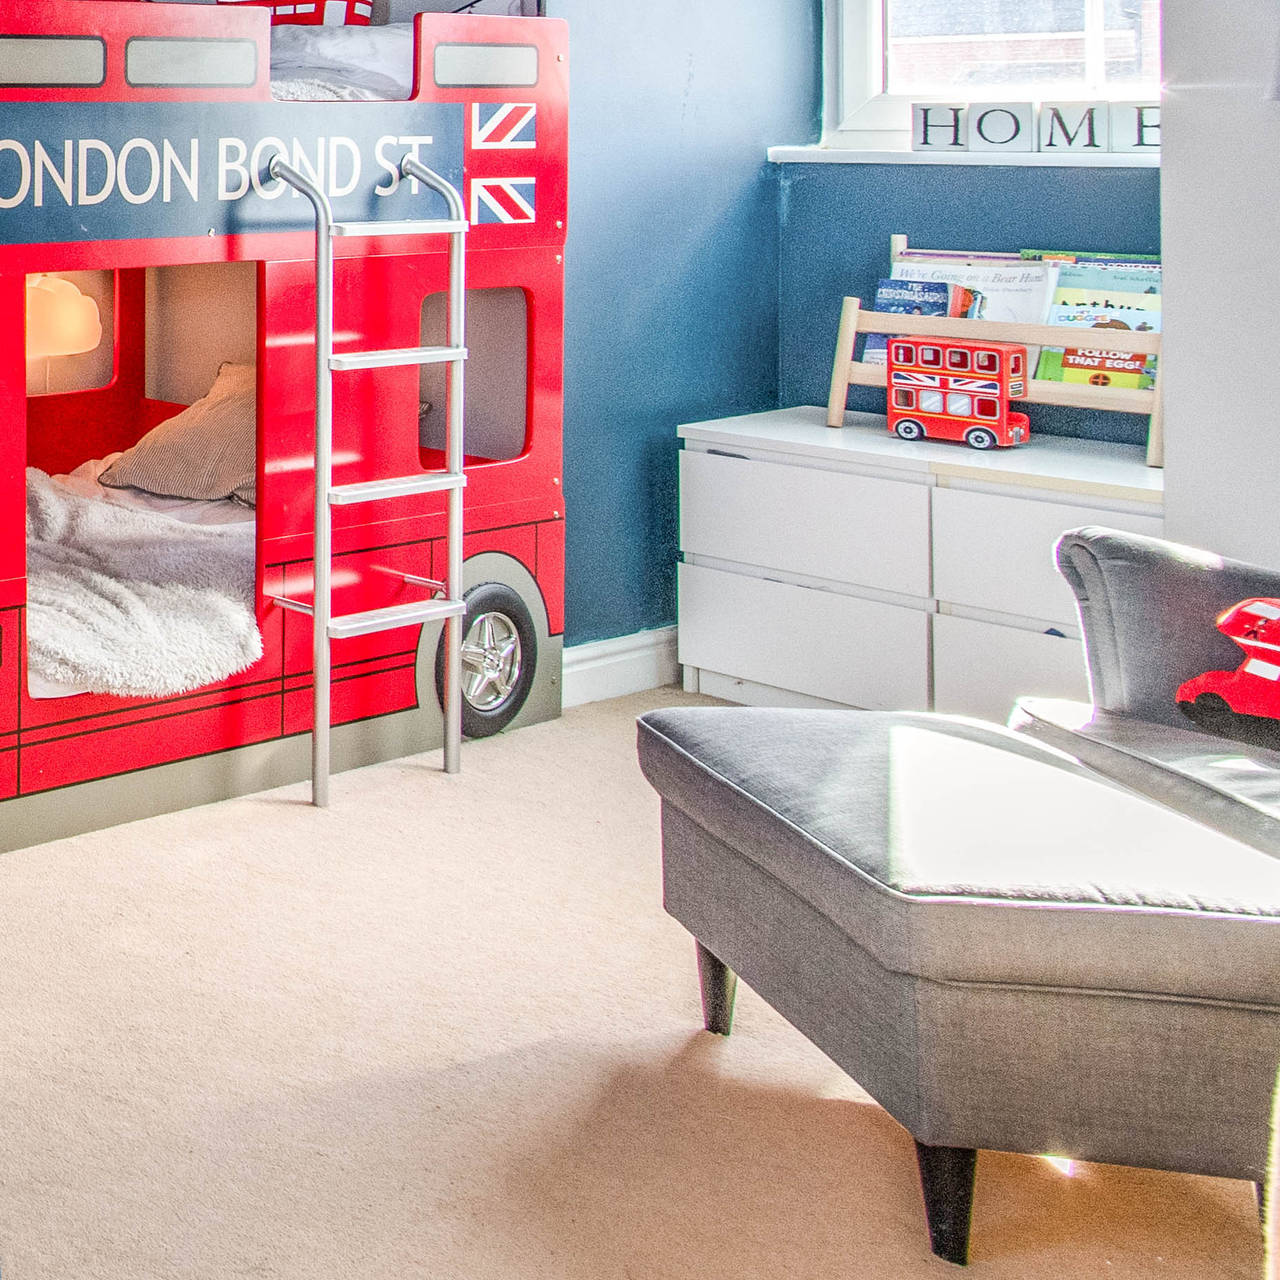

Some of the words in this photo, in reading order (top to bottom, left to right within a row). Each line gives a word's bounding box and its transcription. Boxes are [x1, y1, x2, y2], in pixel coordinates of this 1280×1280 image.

[920, 106, 1161, 148] HOME
[218, 136, 361, 200] BOND
[374, 135, 433, 197] ST
[991, 272, 1017, 283] Bear
[1076, 348, 1134, 360] FOLLOW
[1066, 356, 1102, 367] THAT
[1104, 359, 1141, 369] EGG!
